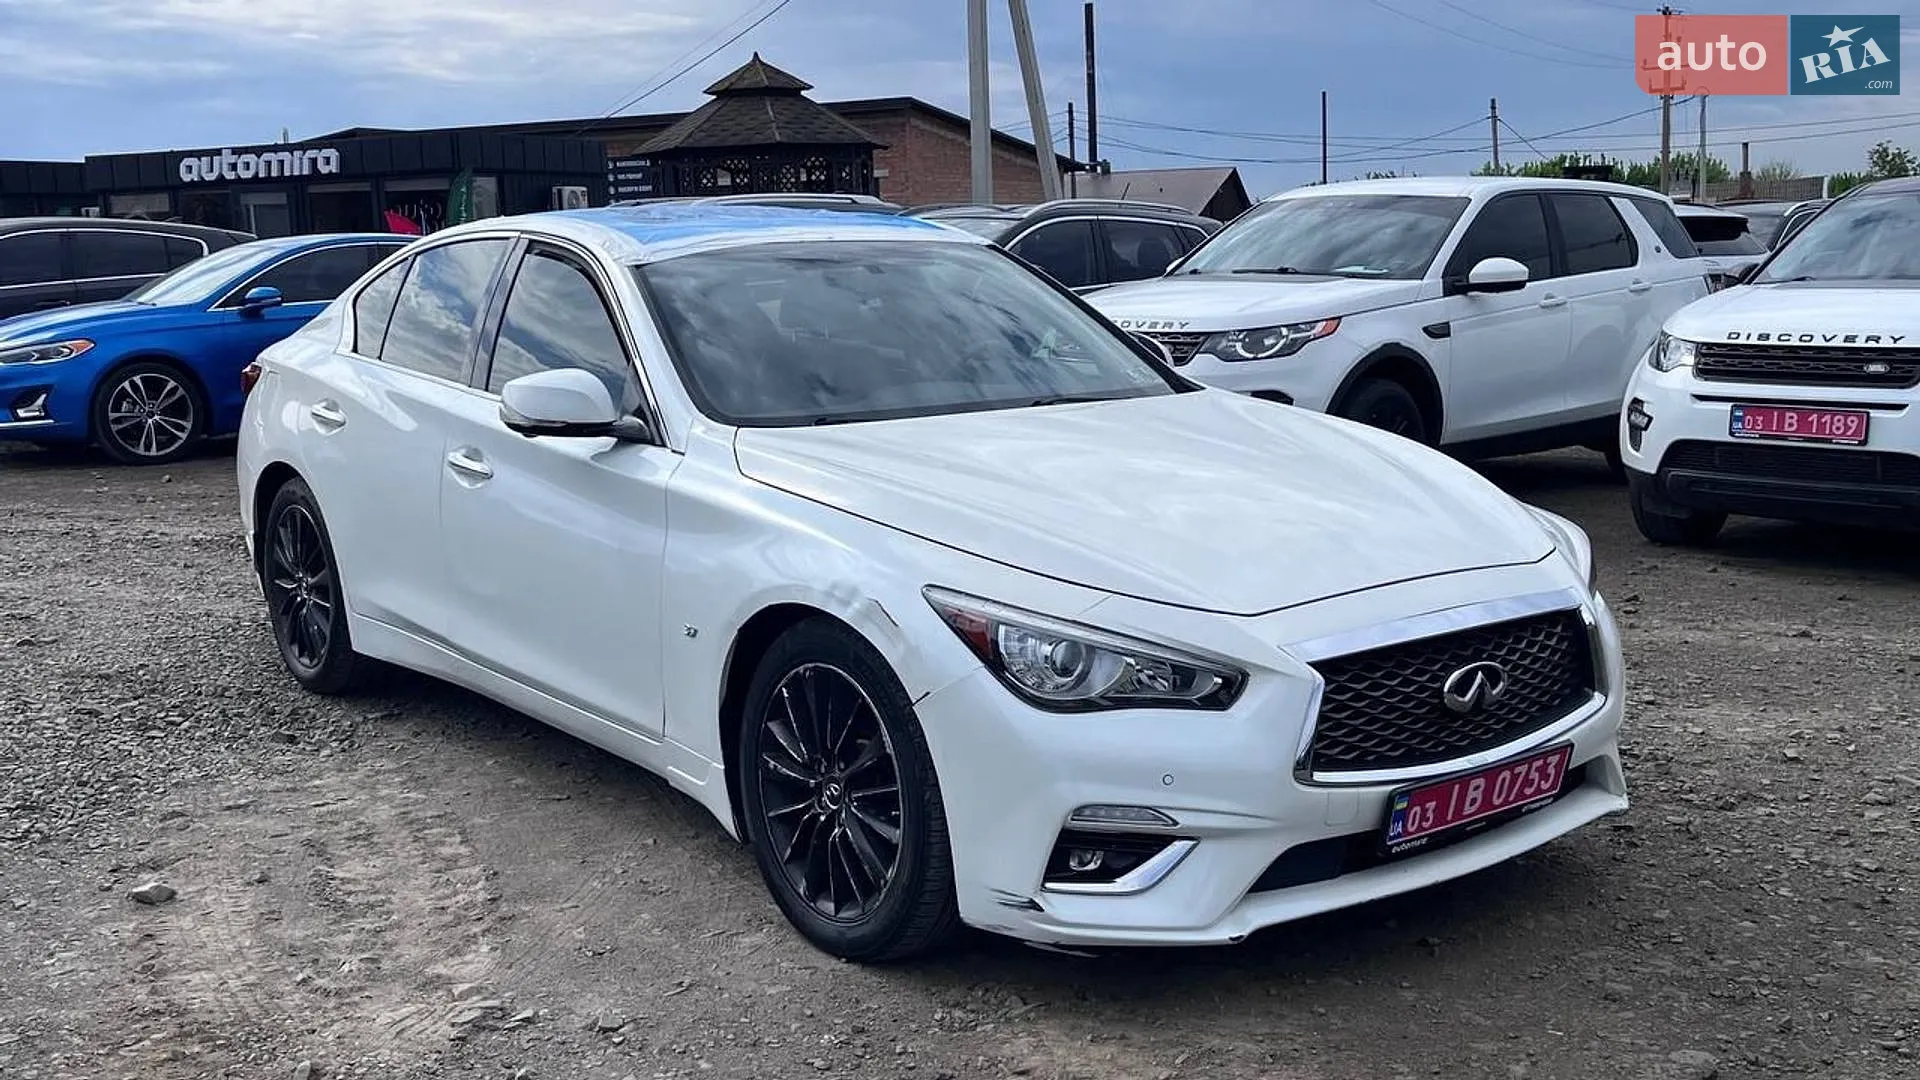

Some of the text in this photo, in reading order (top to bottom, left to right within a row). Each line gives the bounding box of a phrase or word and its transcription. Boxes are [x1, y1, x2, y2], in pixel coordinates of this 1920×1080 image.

[180, 148, 340, 182] automira
[1727, 331, 1905, 345] DISCOVERY
[1744, 415, 1763, 430] 03
[1807, 413, 1859, 436] 1189
[1407, 801, 1436, 832] 03
[1492, 754, 1561, 806] 0753
